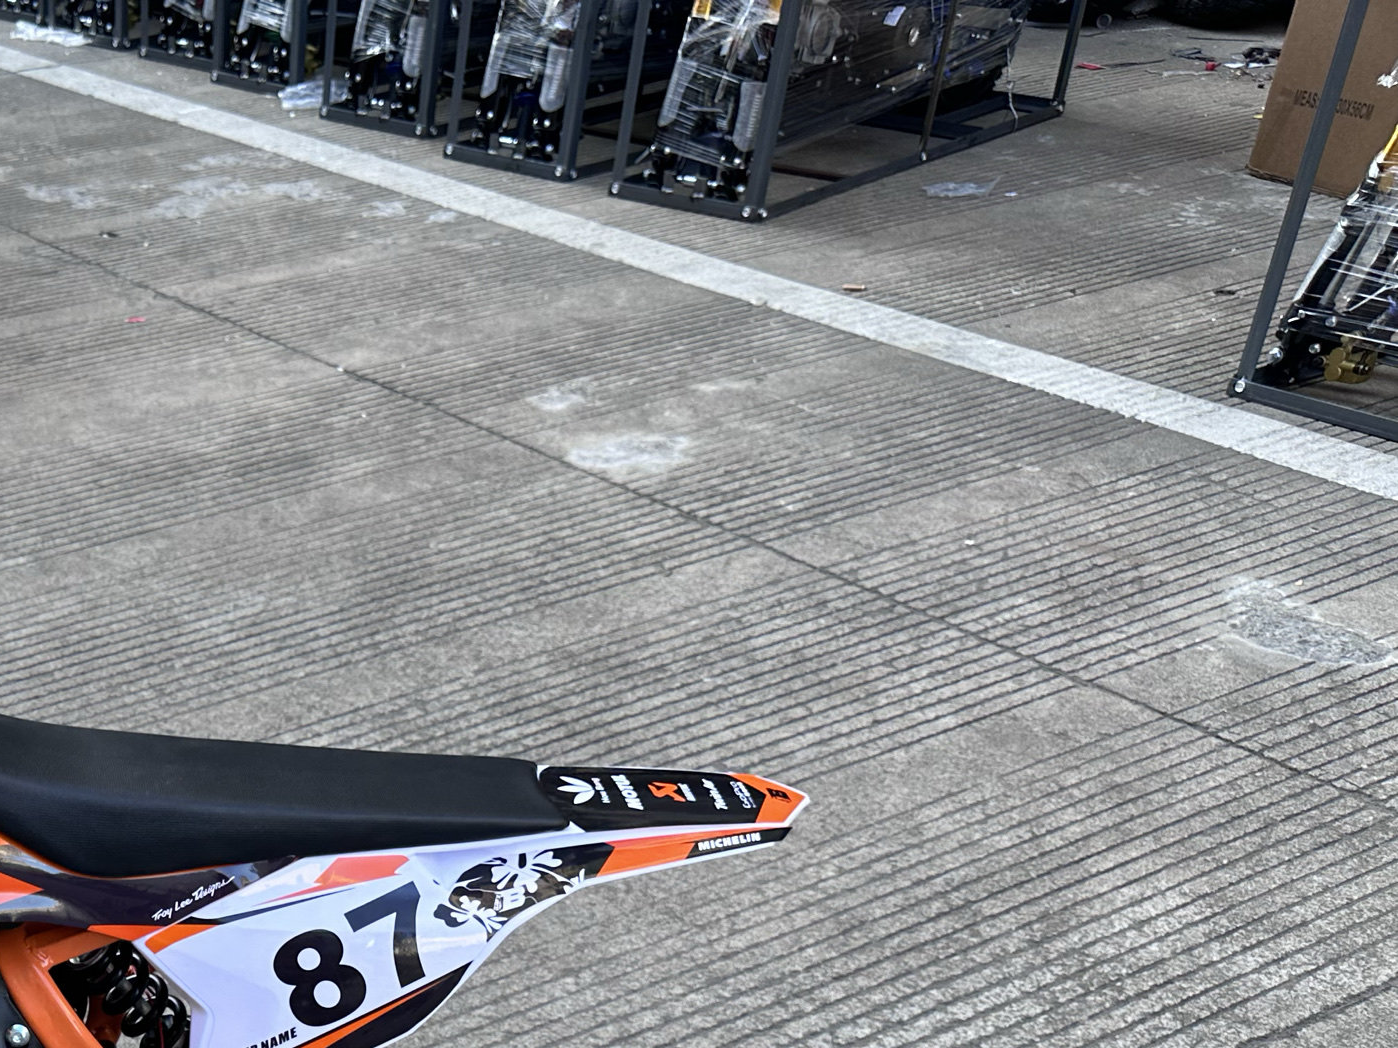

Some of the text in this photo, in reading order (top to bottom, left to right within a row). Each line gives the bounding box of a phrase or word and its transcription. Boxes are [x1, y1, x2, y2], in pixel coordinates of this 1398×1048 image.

[697, 832, 761, 851] MICHELIN
[151, 875, 235, 921] Troy Lee Designs
[273, 881, 426, 1027] 87
